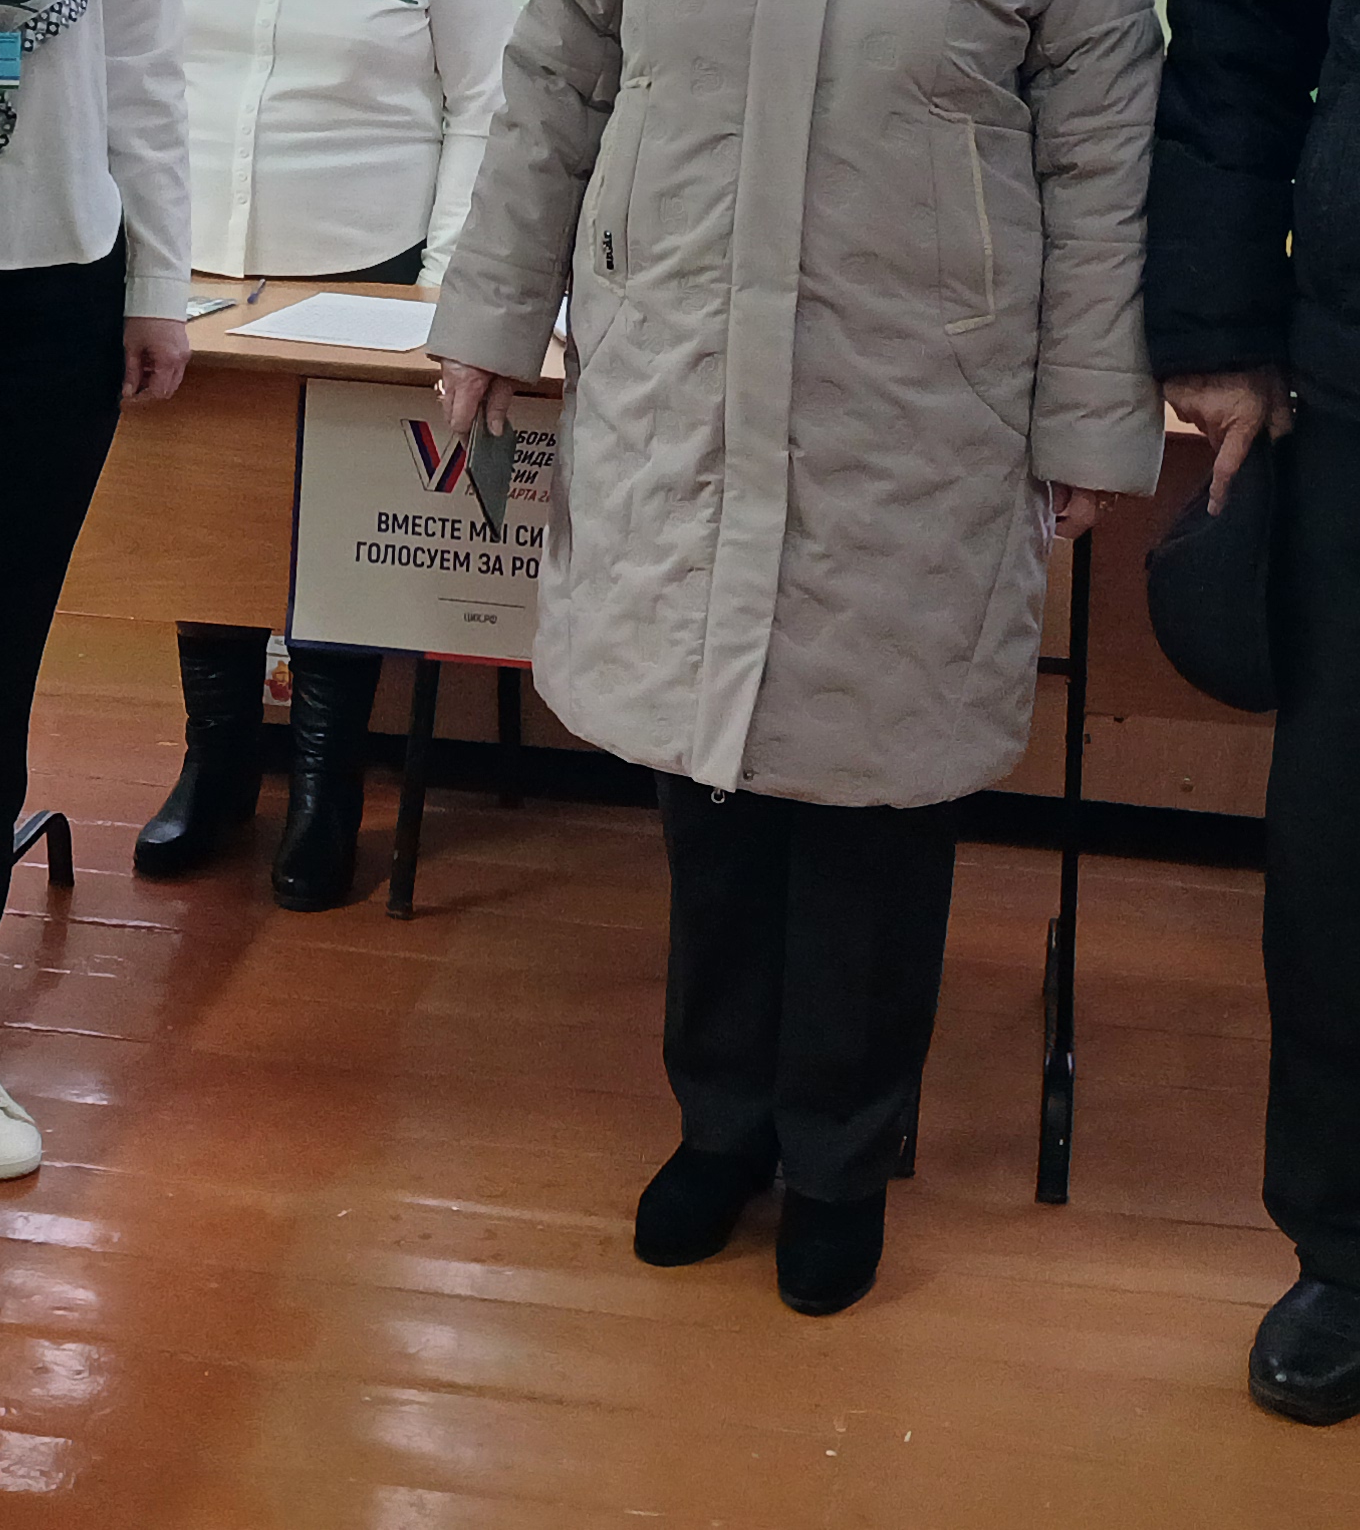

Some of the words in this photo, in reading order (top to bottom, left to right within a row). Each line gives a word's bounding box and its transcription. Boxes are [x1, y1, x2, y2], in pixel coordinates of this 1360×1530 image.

[377, 511, 463, 540] ВМЕСТЕ
[355, 541, 471, 573] ГОЛОСУЕМ
[477, 553, 504, 576] ЗА
